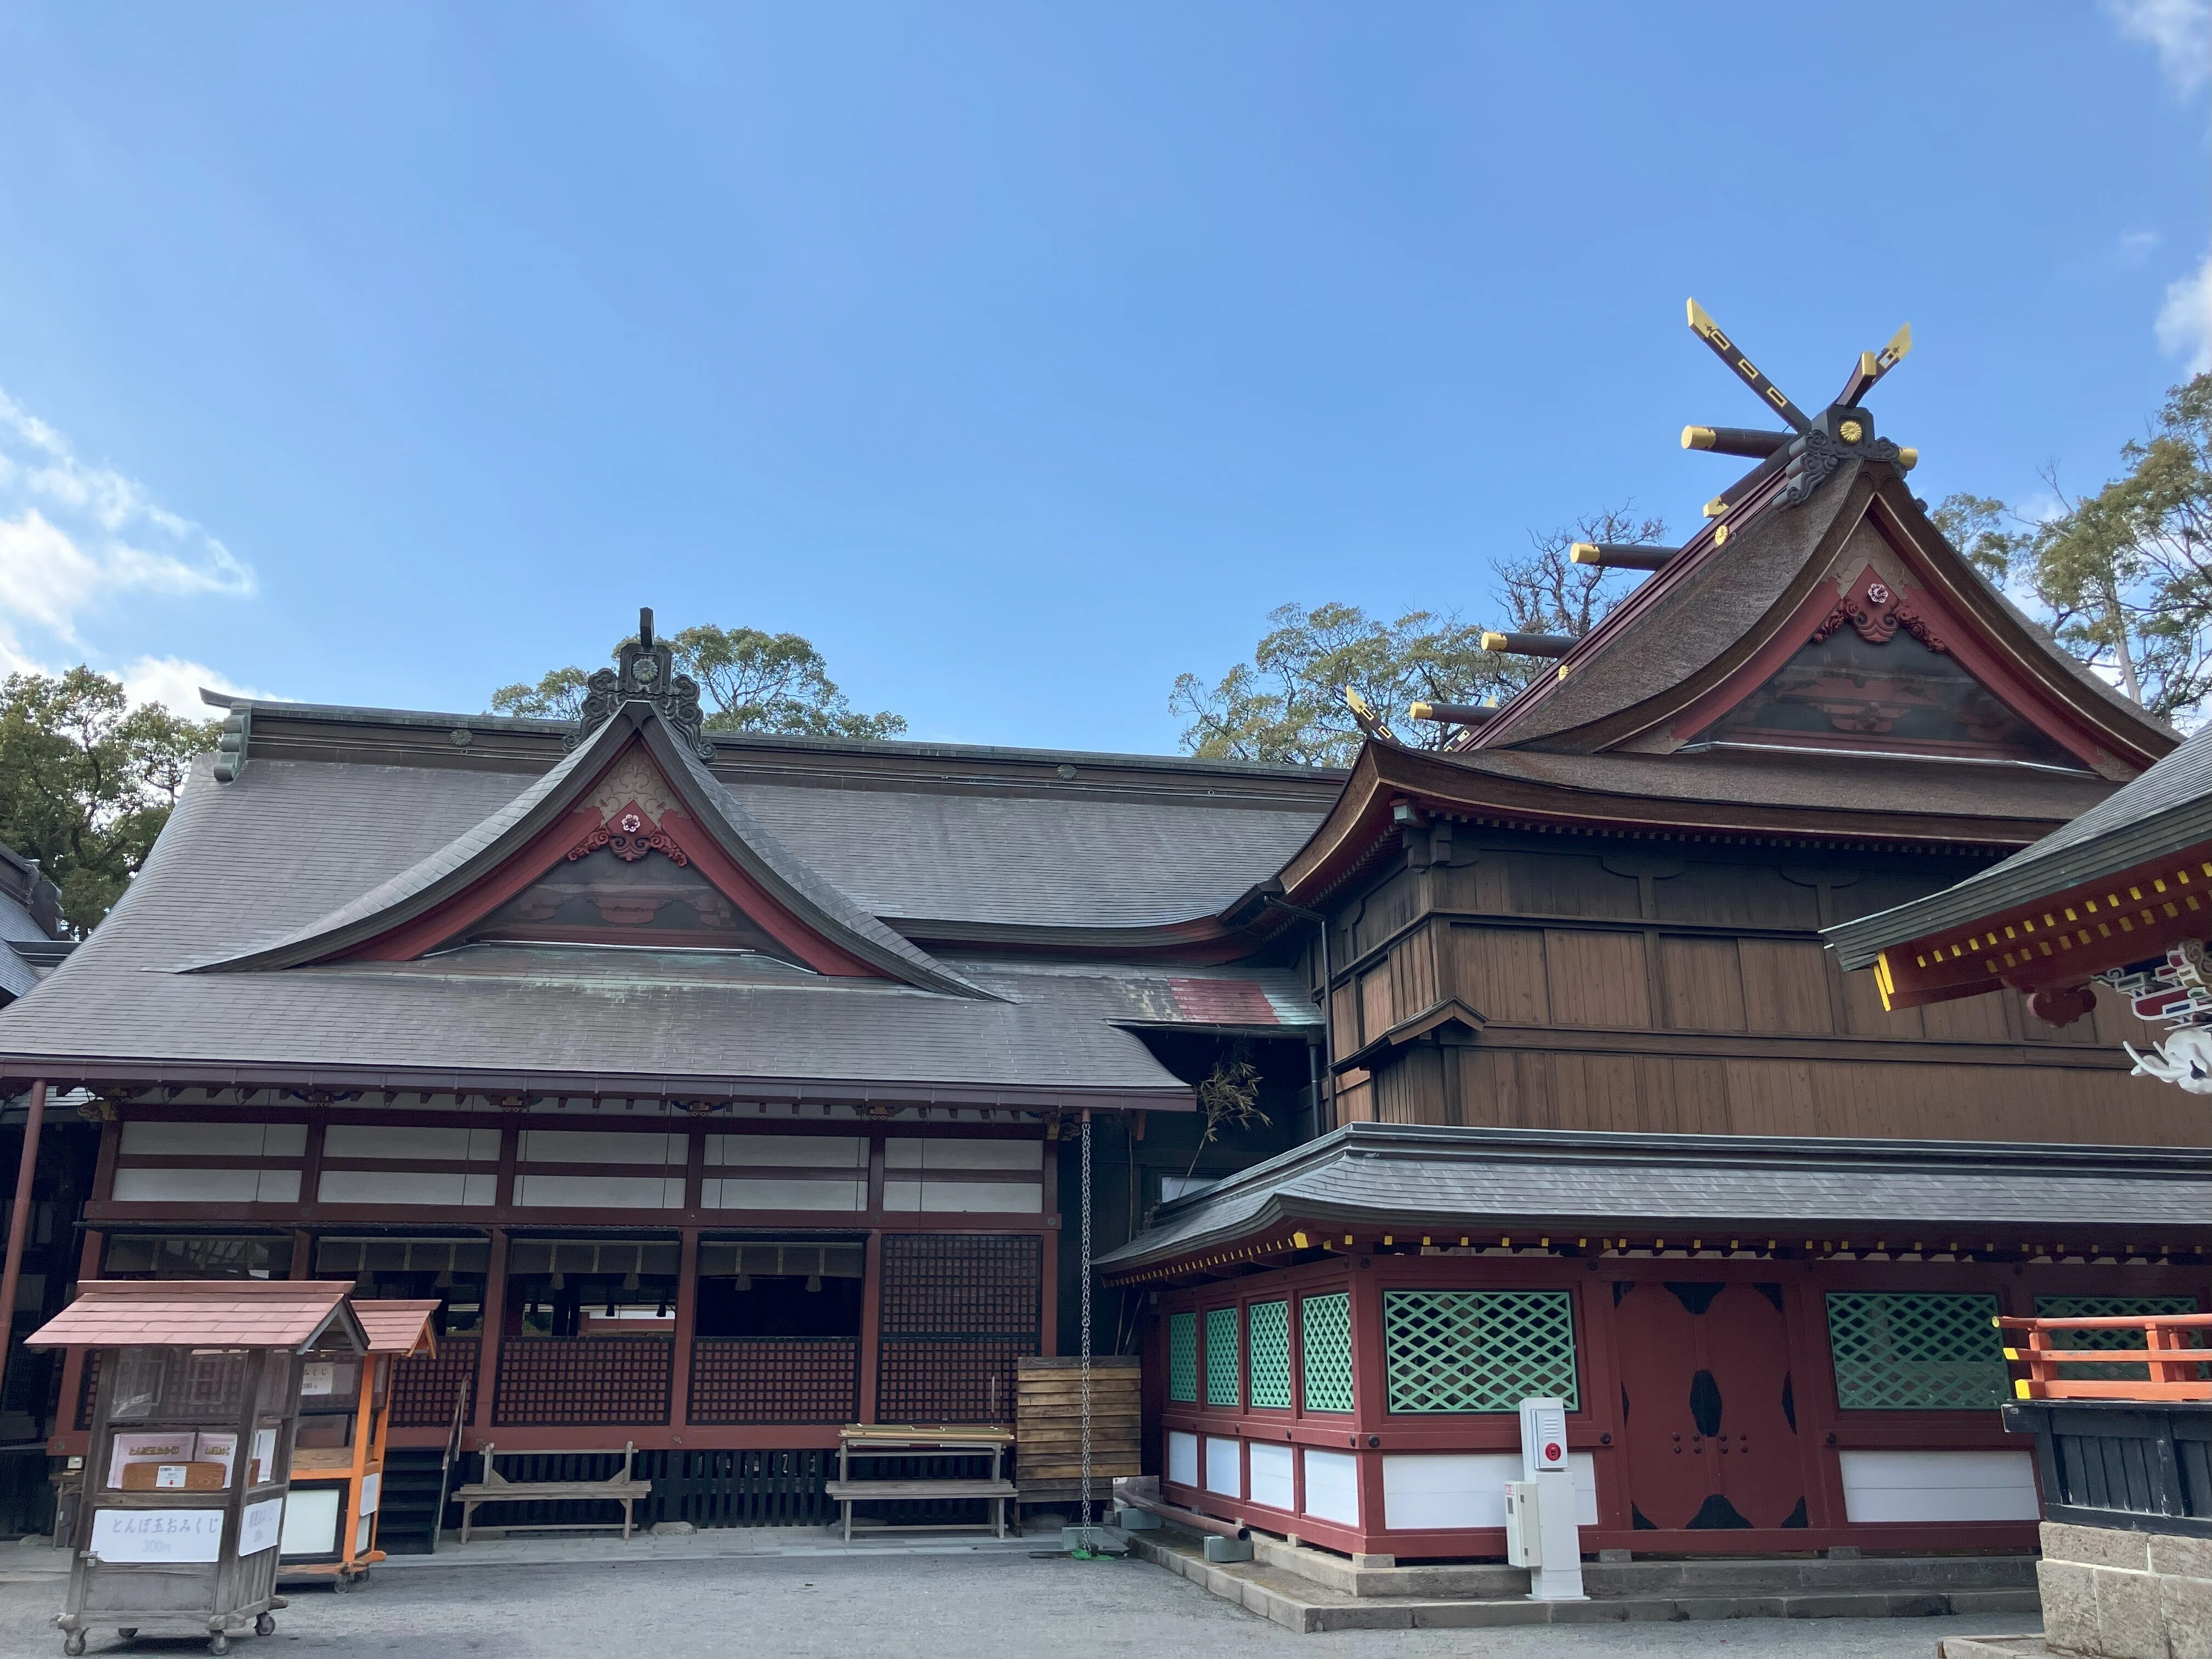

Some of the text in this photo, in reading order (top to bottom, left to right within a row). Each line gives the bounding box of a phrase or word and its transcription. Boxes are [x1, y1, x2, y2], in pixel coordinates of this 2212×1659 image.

[112, 1517, 219, 1533] とんぼ玉おみくじ
